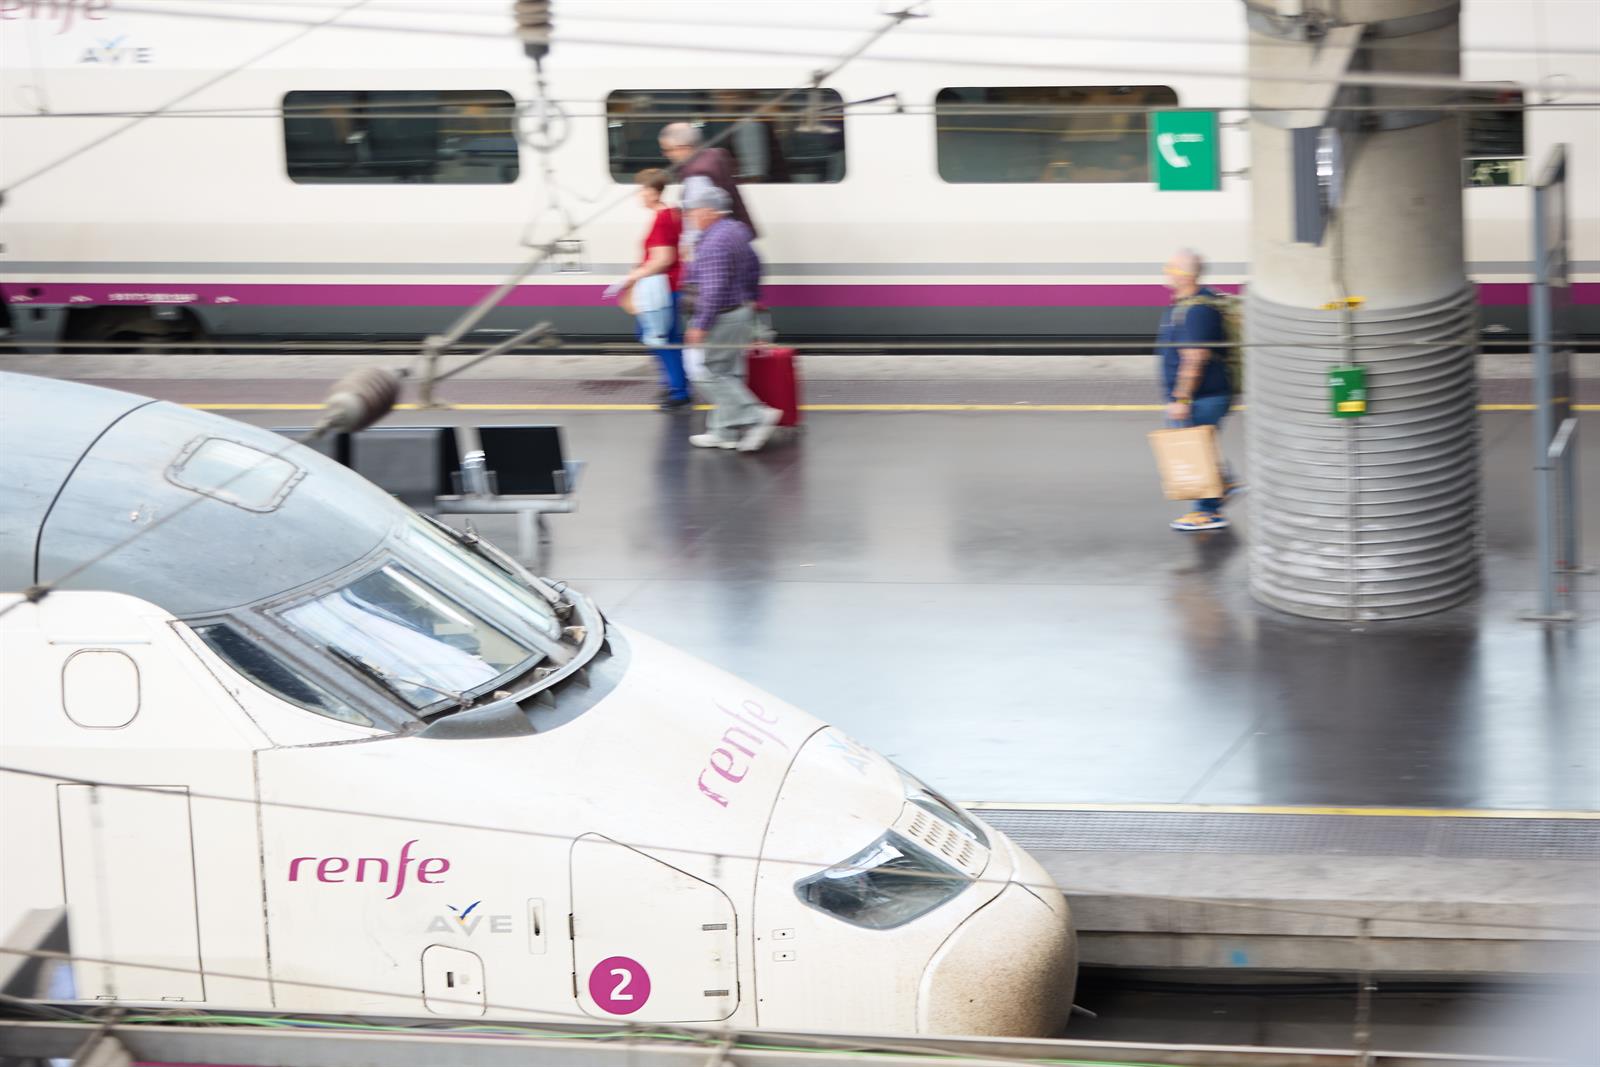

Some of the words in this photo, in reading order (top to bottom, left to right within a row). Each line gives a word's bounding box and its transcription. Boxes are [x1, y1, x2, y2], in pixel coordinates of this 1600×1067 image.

[80, 41, 154, 64] AVE
[697, 697, 790, 808] renfe
[287, 839, 451, 900] renfe
[424, 906, 513, 937] AVE
[609, 968, 634, 1001] 2
